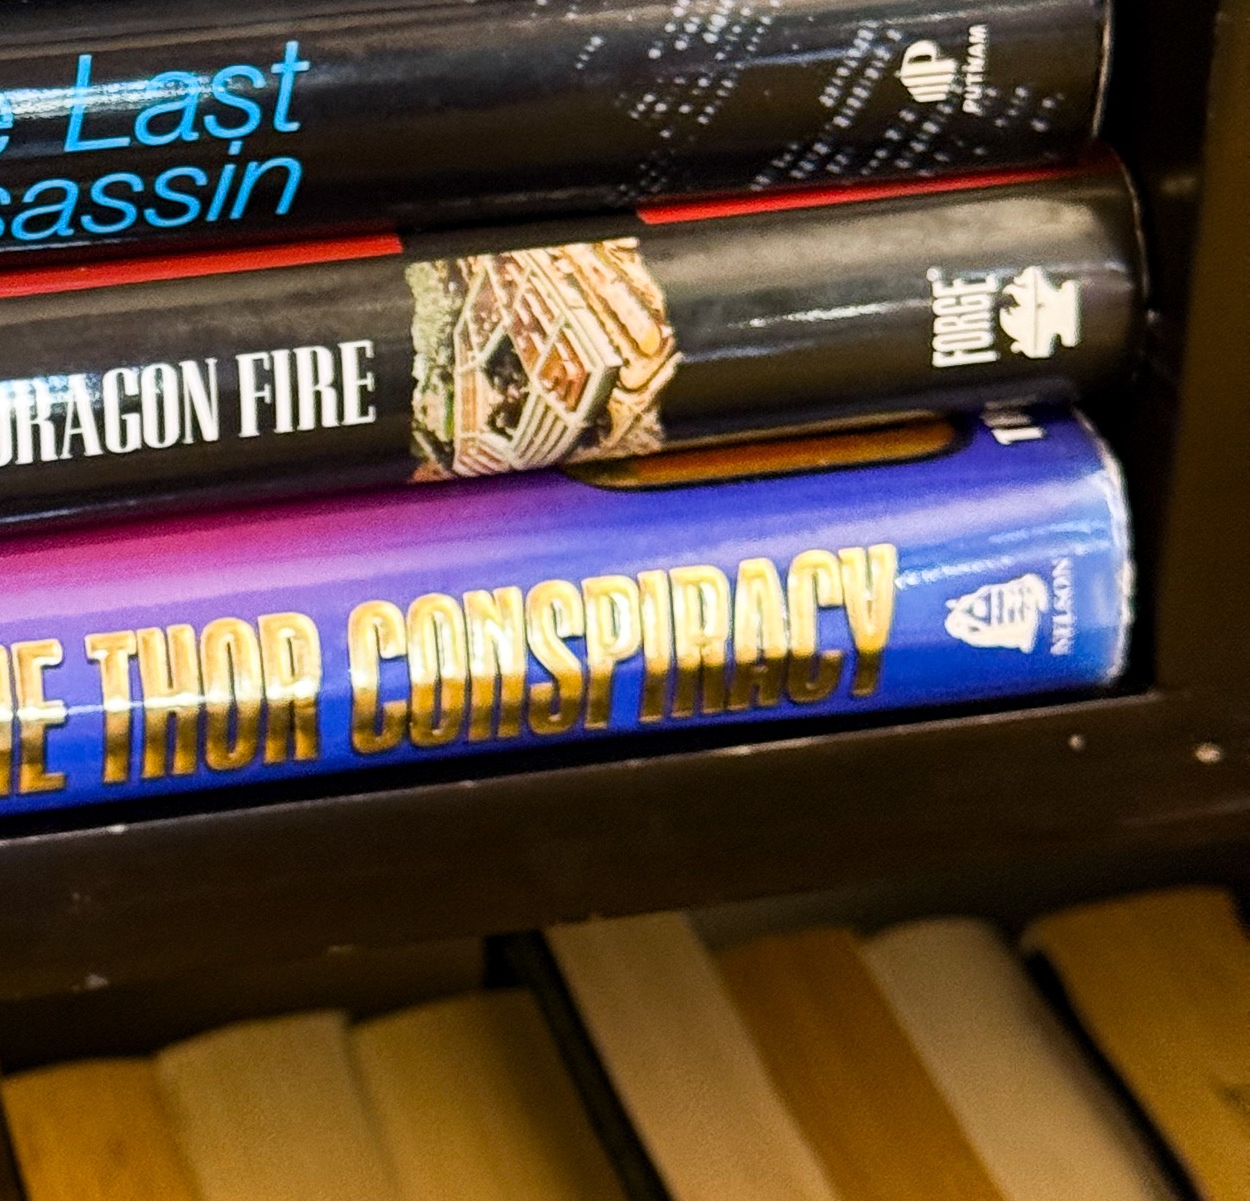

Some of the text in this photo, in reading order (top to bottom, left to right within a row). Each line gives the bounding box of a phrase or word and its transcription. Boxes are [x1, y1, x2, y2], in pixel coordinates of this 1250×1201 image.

[63, 40, 310, 154] Last
[926, 267, 1000, 368] FORGE
[234, 339, 377, 439] FIRE
[85, 611, 323, 785] THOR
[347, 542, 899, 756] CONSPIRACY
